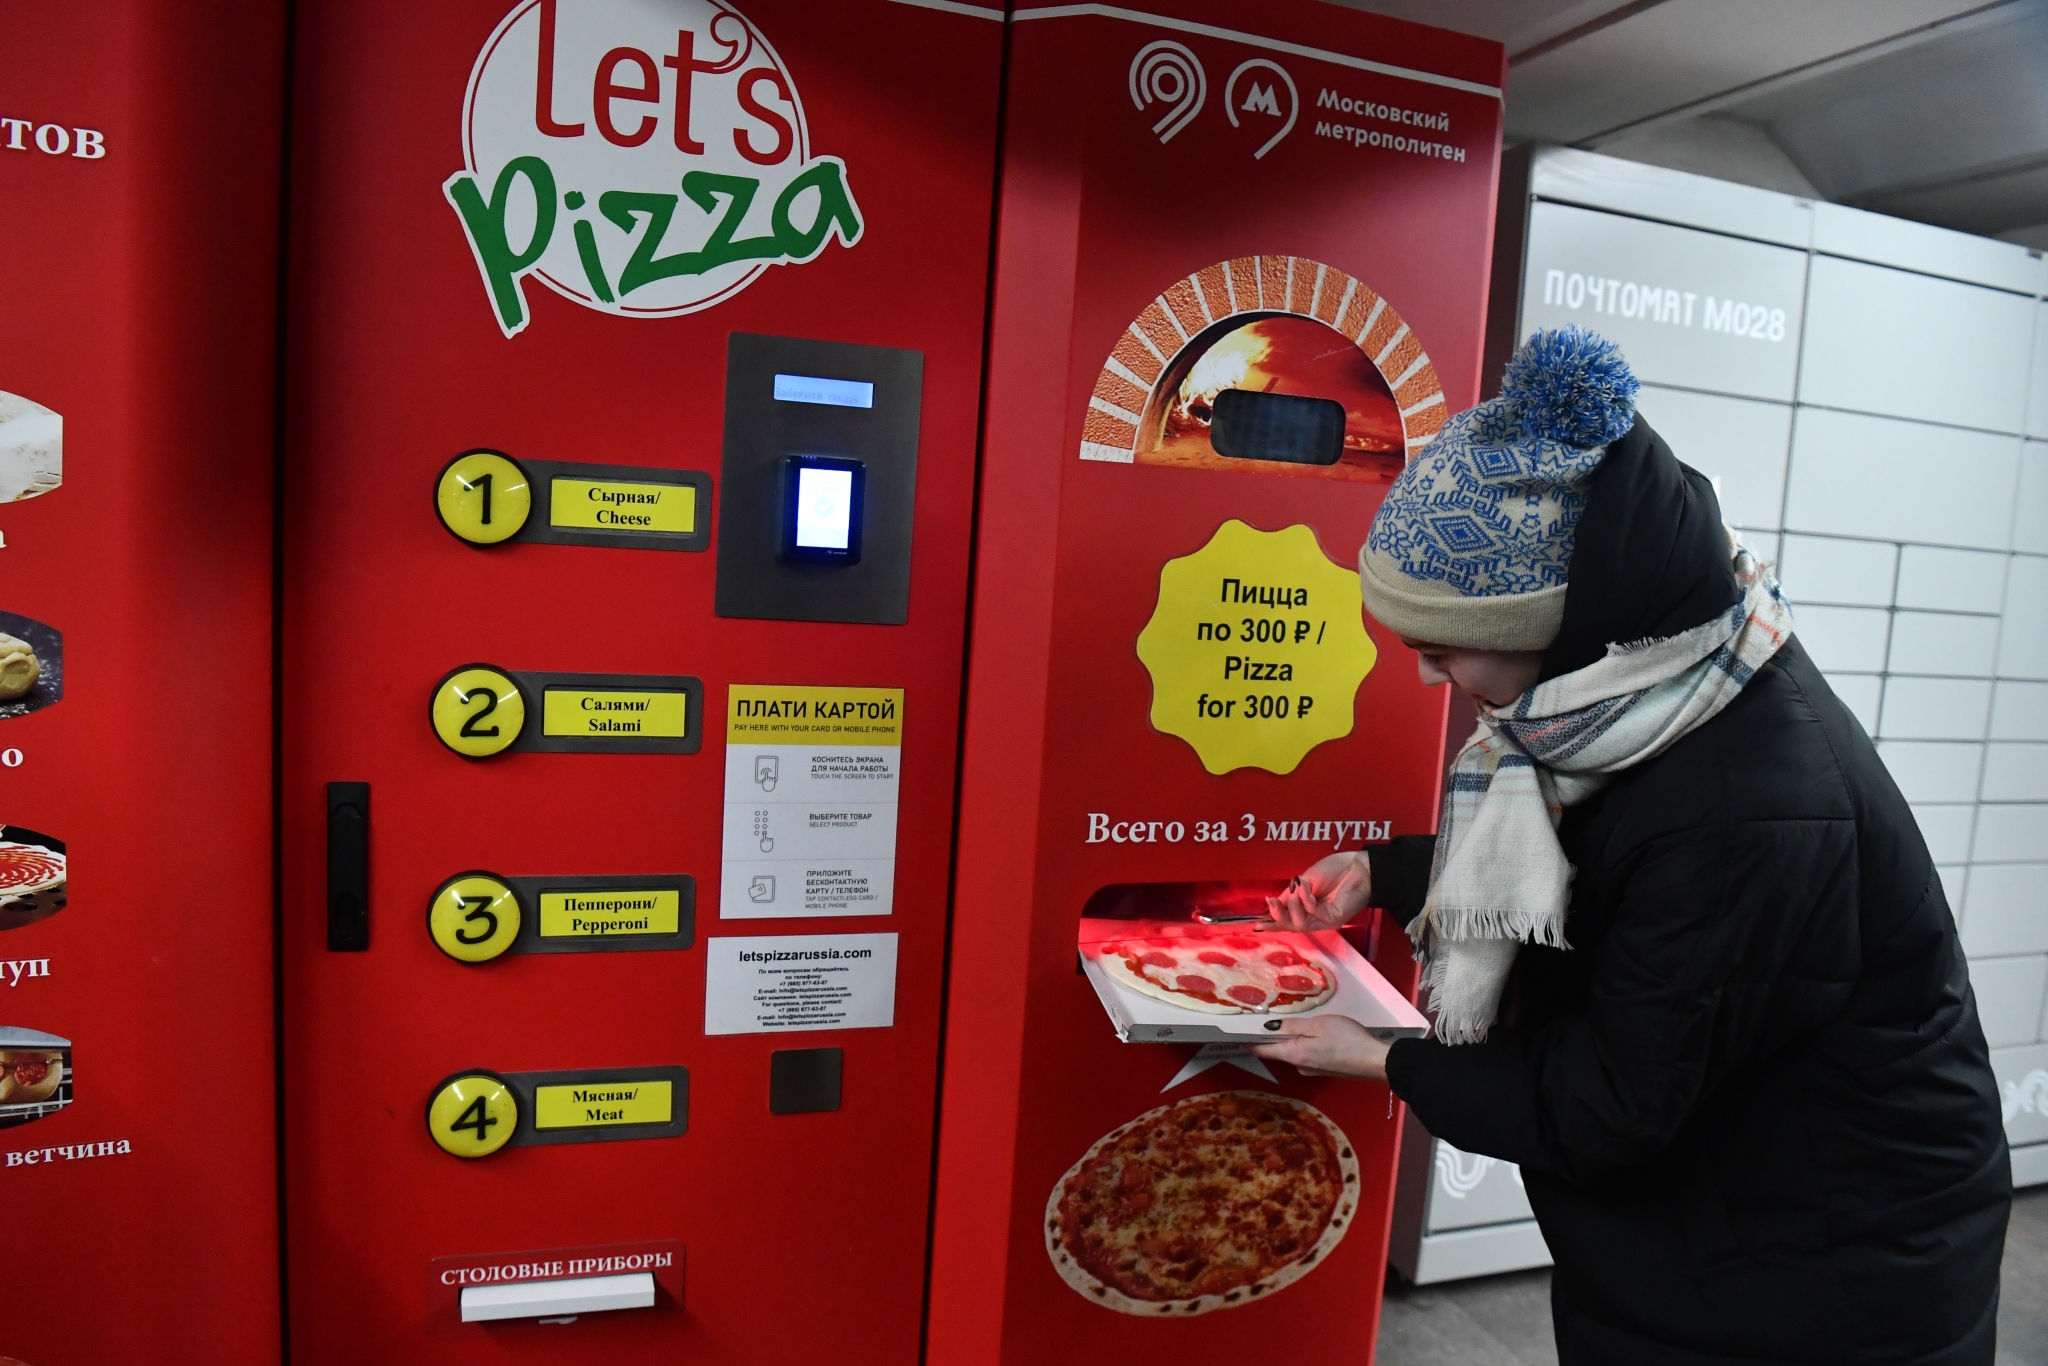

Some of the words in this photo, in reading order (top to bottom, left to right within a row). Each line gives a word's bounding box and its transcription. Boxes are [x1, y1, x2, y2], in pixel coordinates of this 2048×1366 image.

[1316, 88, 1449, 132] Московский
[1314, 120, 1466, 163] метрополитен
[1544, 269, 1698, 327] ПОЧТОМАТ
[775, 386, 823, 400] Заберите
[463, 472, 492, 525] 1
[588, 487, 661, 506] Сырная/
[596, 509, 651, 526] Cheese
[1221, 578, 1308, 610] Пицца
[1197, 622, 1231, 642] по
[1240, 618, 1286, 643] 300
[1293, 620, 1311, 644] ₽
[1224, 655, 1293, 682] Pizza
[459, 687, 499, 737] 2
[580, 697, 651, 712] Салями/
[737, 699, 807, 718] ПЛАТИ
[814, 698, 895, 720] КАРТОЙ
[1197, 693, 1236, 718] for
[1243, 694, 1289, 719] 300
[1296, 695, 1314, 719] ₽
[588, 718, 641, 732] Salami
[771, 724, 789, 732] WITH
[811, 725, 830, 733] CARD
[832, 725, 842, 733] OR
[843, 725, 870, 733] MOBILE
[811, 765, 828, 773] ДЛЯ
[1085, 812, 1185, 844] Всего
[1193, 820, 1228, 842] за
[1237, 813, 1256, 842] 3
[1264, 820, 1392, 850] минуты
[806, 878, 868, 886] БЕСКОНТАКТНУЮ
[836, 886, 869, 894] ТЕЛЕФОН
[564, 896, 657, 914] Пепперони/
[455, 895, 498, 945] 3
[572, 917, 648, 934] Pepperoni
[739, 948, 871, 963] letspizzarussia.com
[572, 1087, 638, 1103] Мясная/
[450, 1095, 498, 1141] 4
[586, 1108, 624, 1122] Meat
[5, 1139, 132, 1167] ветчина
[440, 1260, 564, 1286] СТОЛОВЫЕ
[568, 1251, 673, 1275] ПРИБОРЫ
